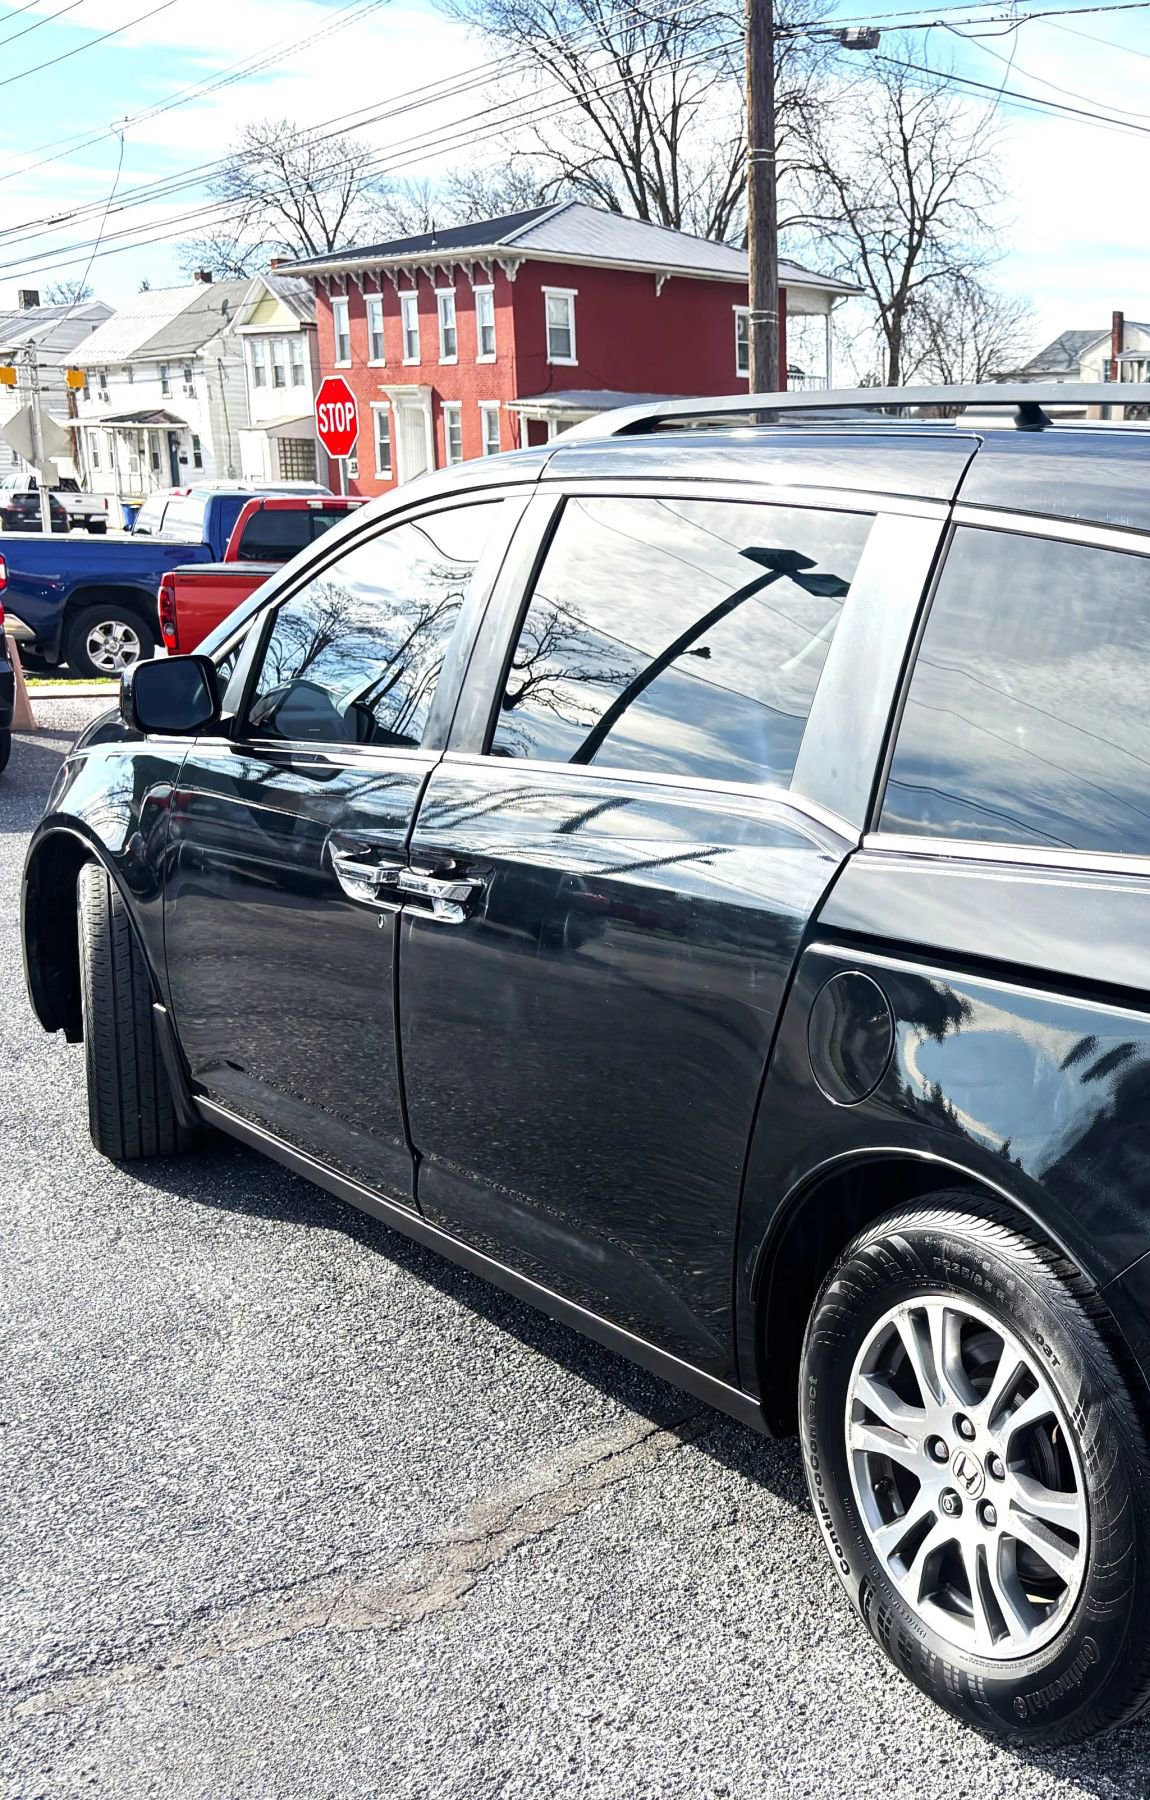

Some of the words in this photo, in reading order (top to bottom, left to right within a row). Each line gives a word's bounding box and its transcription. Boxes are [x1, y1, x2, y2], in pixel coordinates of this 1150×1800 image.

[318, 401, 355, 433] STOP
[1030, 1325, 1061, 1368] 103T
[808, 1375, 851, 1577] ContiProContact
